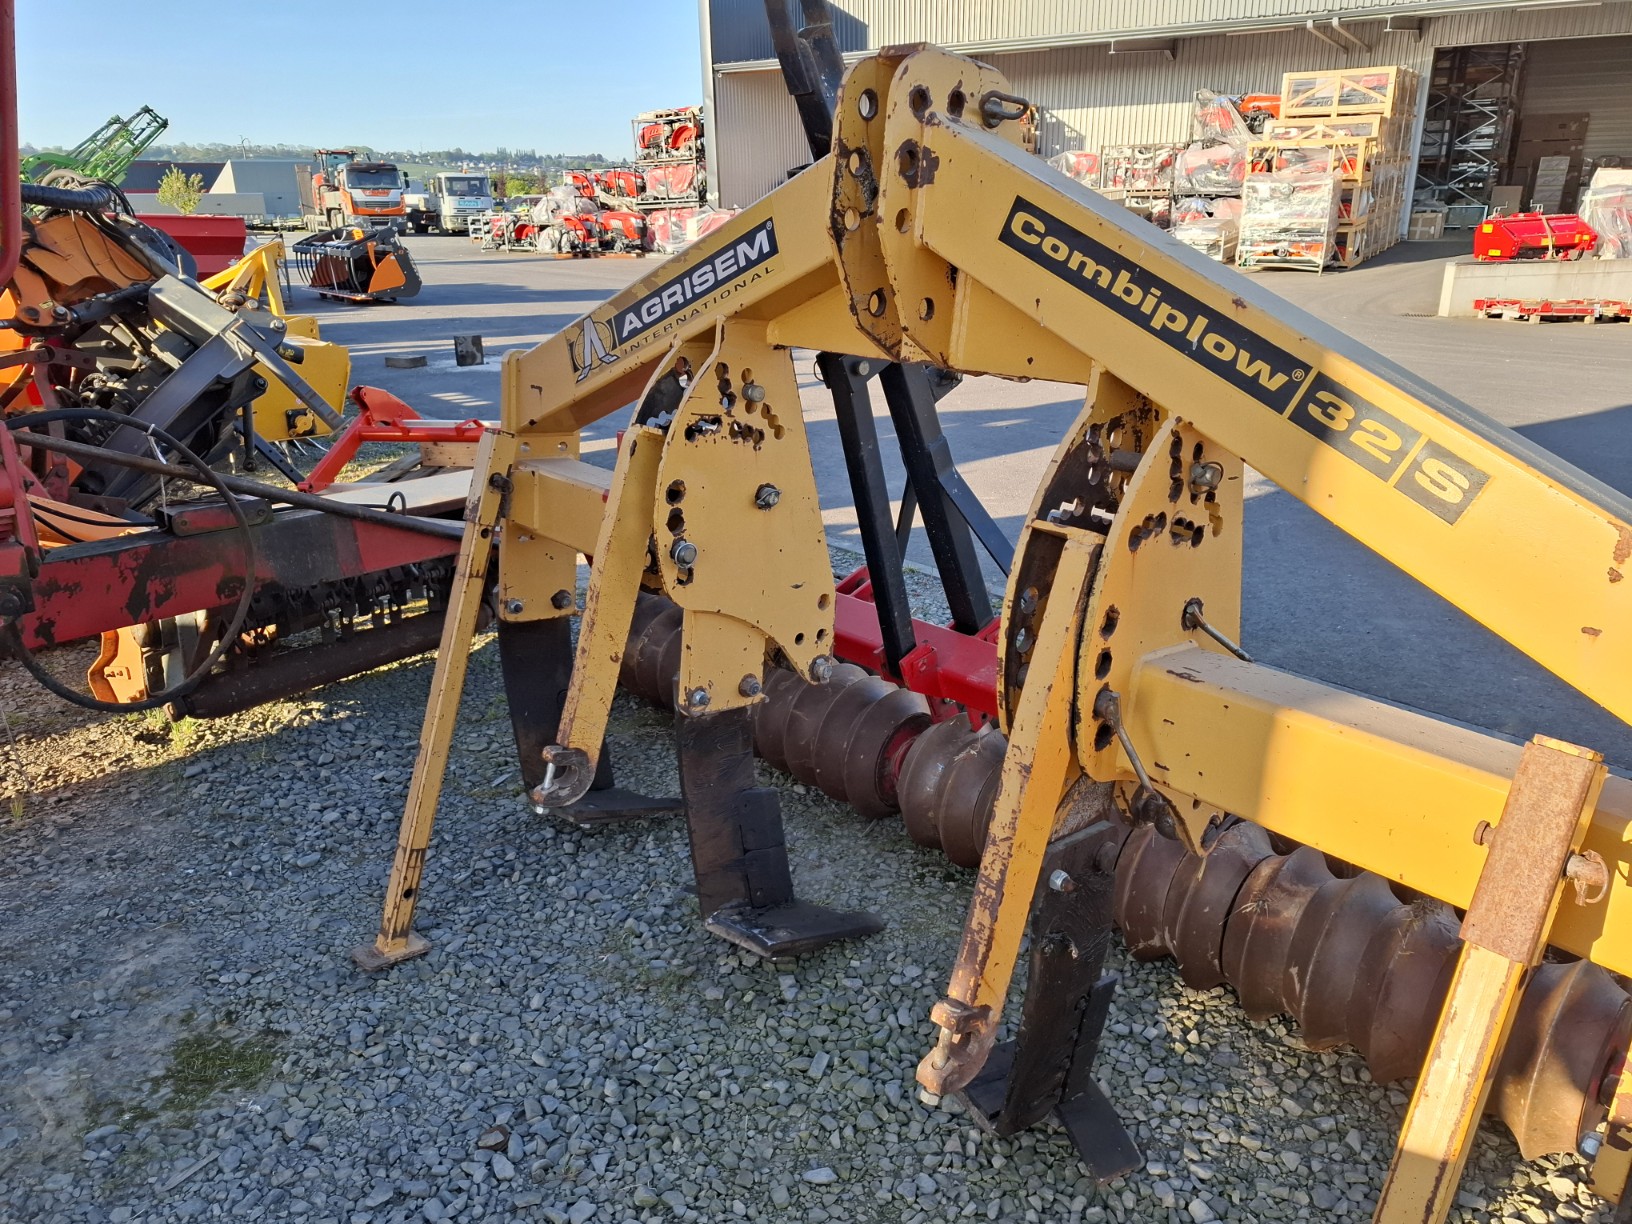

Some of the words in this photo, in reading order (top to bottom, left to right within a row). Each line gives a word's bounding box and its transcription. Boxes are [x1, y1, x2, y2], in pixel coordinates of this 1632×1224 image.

[623, 266, 775, 355] INTERNATIONAL
[1307, 390, 1402, 464] 32
[1414, 457, 1470, 504] S
